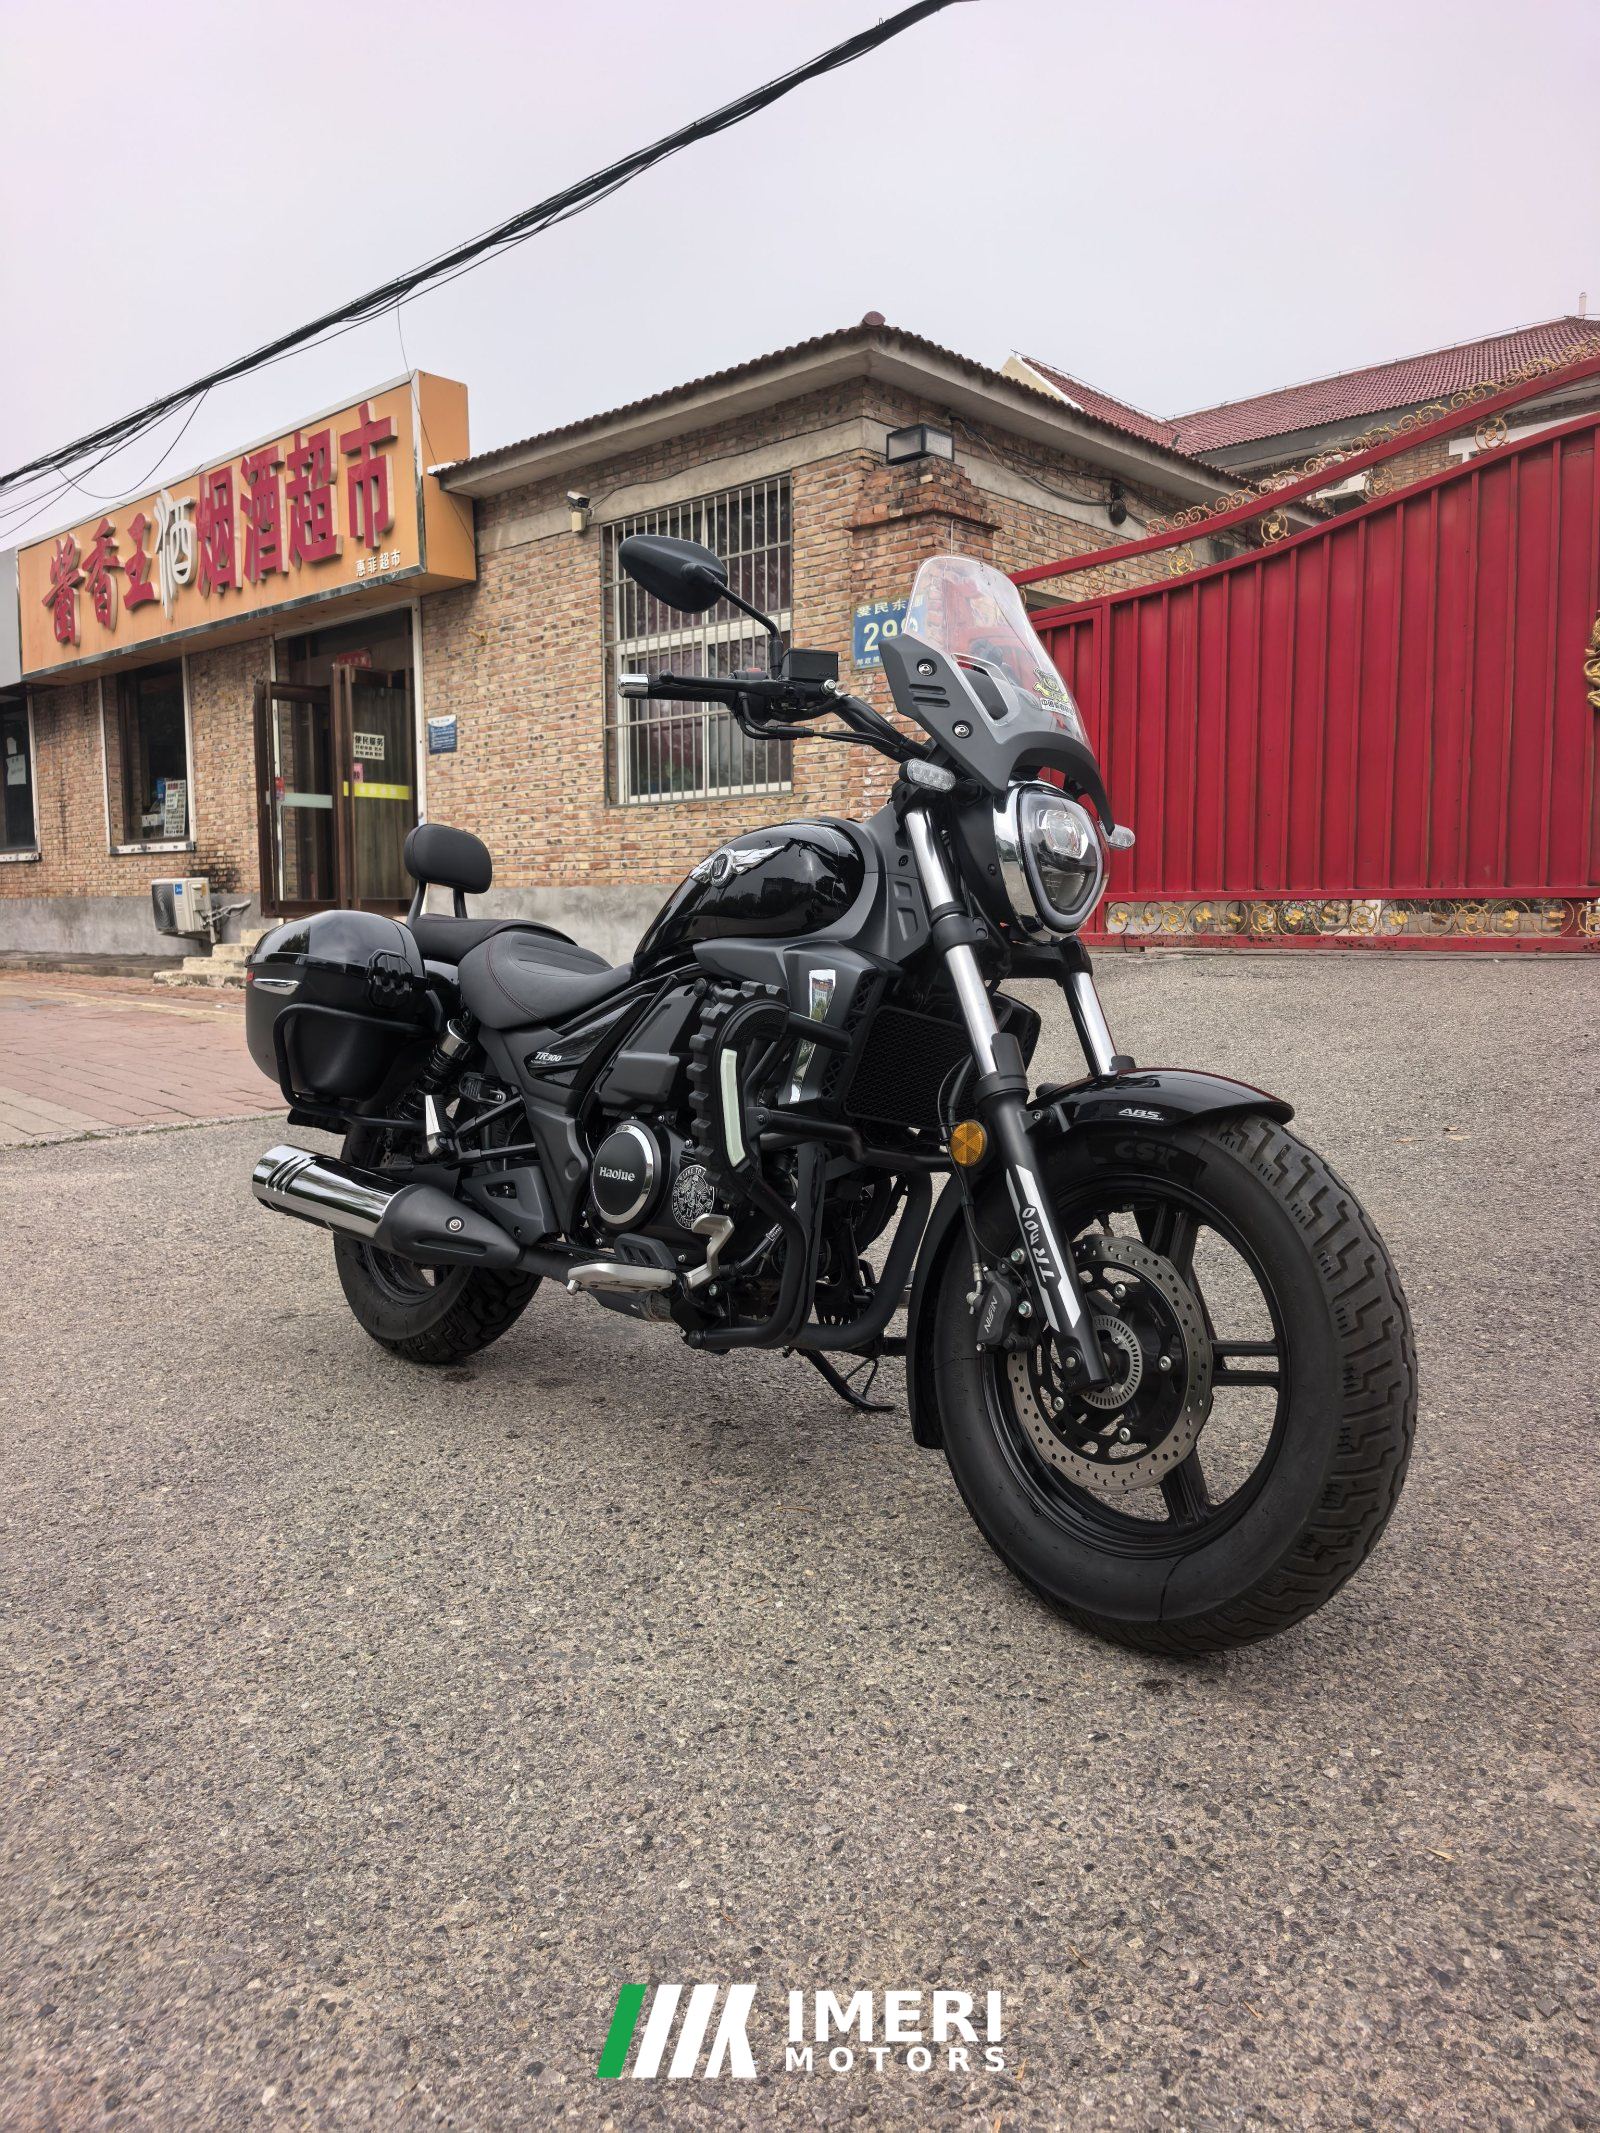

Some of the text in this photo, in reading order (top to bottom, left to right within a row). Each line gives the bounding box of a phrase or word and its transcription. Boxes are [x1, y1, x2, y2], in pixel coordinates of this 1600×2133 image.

[535, 1051, 562, 1062] TR300
[1118, 1108, 1161, 1118] ABS
[1114, 1140, 1179, 1171] CST
[599, 1166, 636, 1182] Haojue
[1021, 1207, 1055, 1283] TR300
